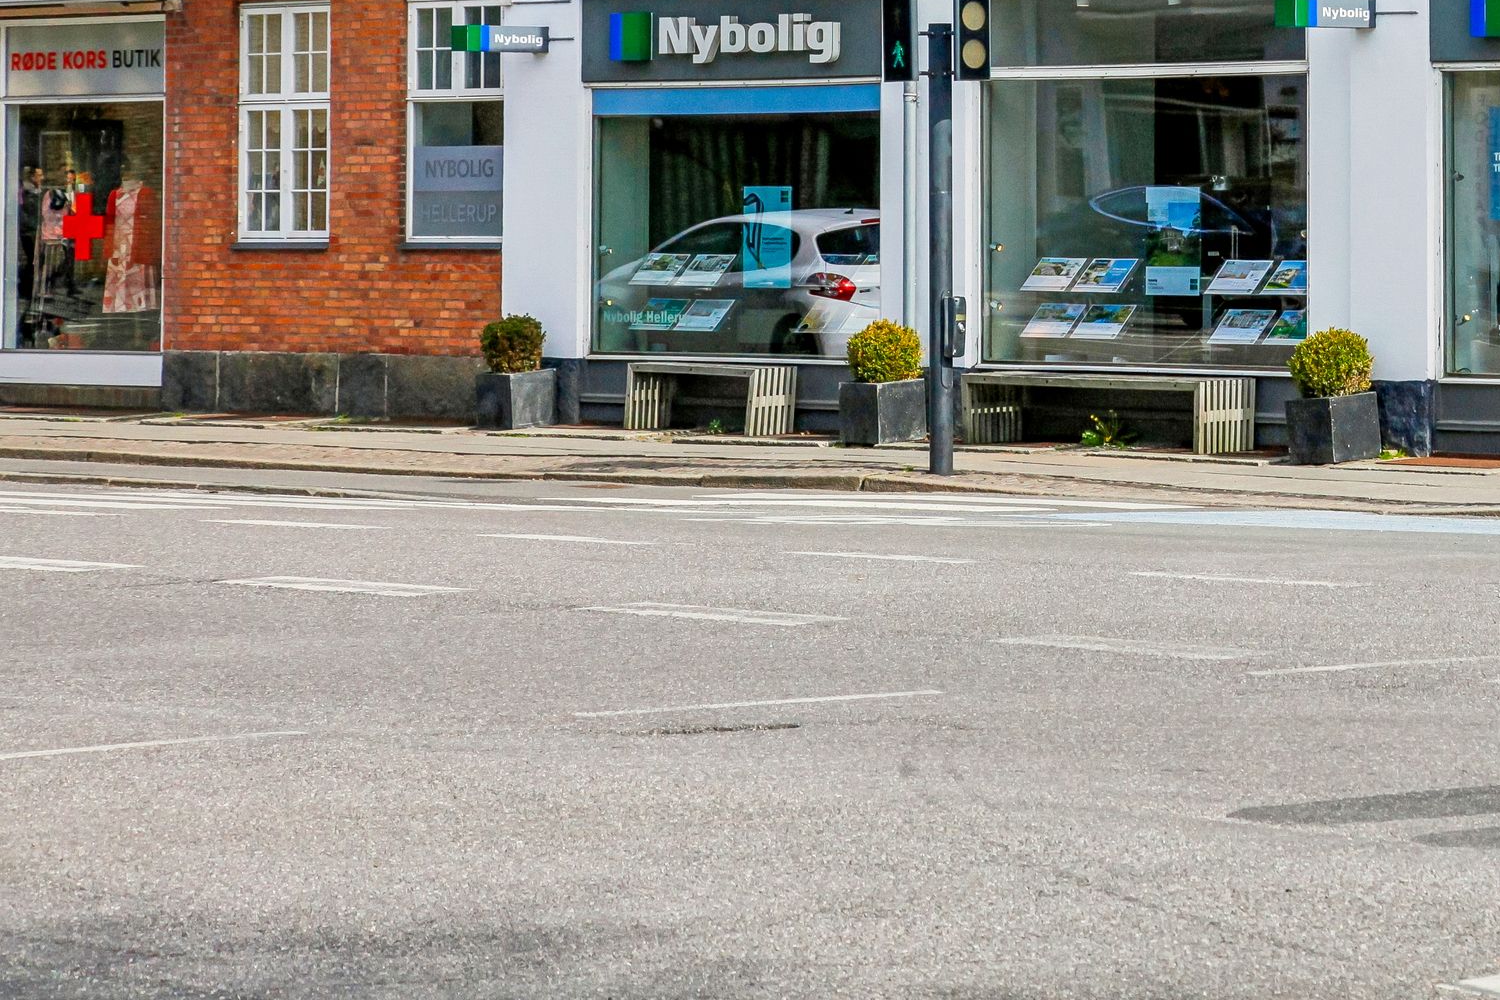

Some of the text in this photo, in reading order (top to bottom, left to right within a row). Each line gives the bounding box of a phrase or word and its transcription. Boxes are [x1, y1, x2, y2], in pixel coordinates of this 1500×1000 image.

[1322, 7, 1370, 21] Nybolig
[494, 33, 543, 46] Nybolig
[658, 13, 841, 64] Nybolig
[11, 49, 161, 71] RØDE KORS BUTIK
[425, 159, 494, 178] NYBOLIG
[420, 203, 497, 223] HELLERUP
[603, 310, 643, 326] Nybolig
